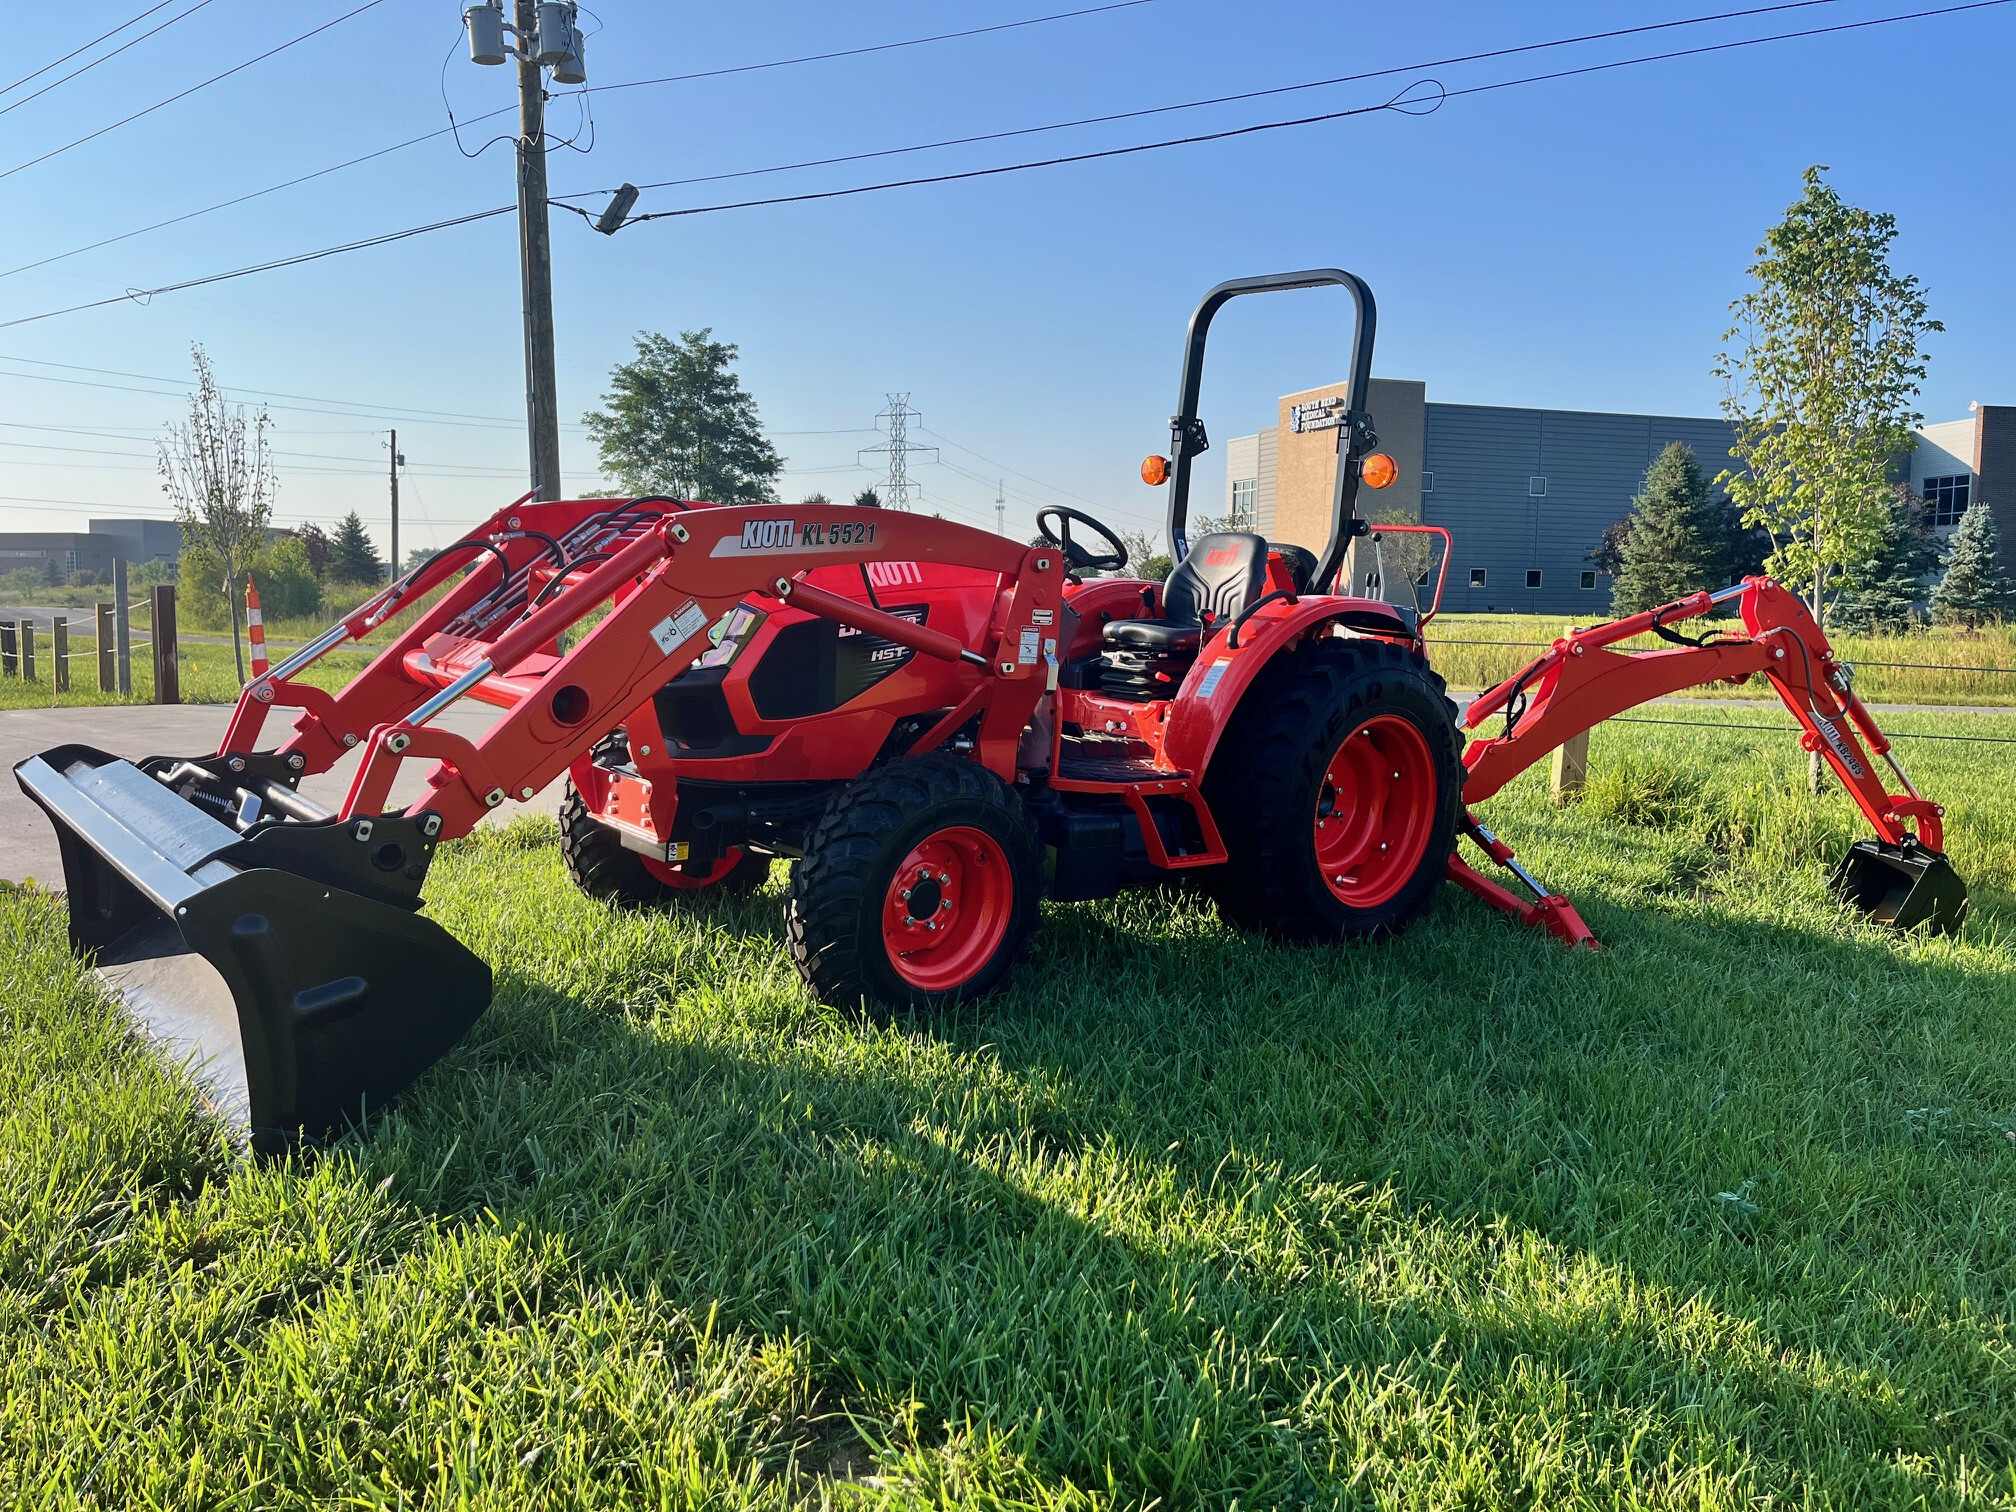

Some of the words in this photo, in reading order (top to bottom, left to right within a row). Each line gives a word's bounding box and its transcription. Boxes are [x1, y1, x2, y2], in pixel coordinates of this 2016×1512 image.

[741, 519, 795, 549] KIOTI
[864, 561, 923, 588] KIOTI
[871, 647, 906, 662] HST
[1836, 741, 1863, 775] KB2485
